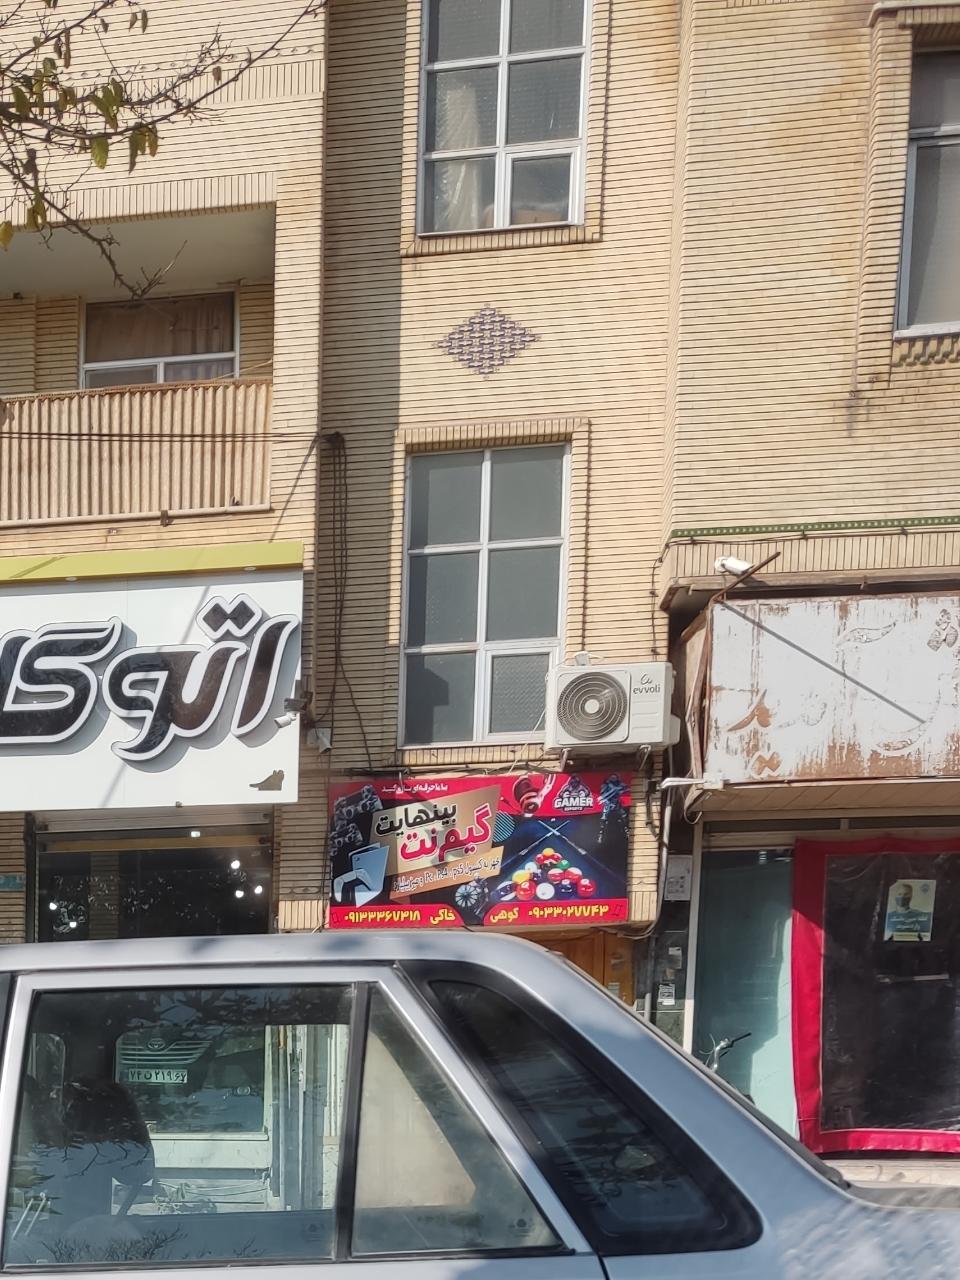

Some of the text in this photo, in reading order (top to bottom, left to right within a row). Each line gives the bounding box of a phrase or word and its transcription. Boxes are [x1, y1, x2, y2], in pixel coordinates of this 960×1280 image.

[633, 684, 661, 694] evvoli
[554, 797, 594, 808] GAMER
[375, 803, 458, 837] بینهایت
[430, 908, 456, 924] خاکی
[490, 906, 519, 923] کوهی
